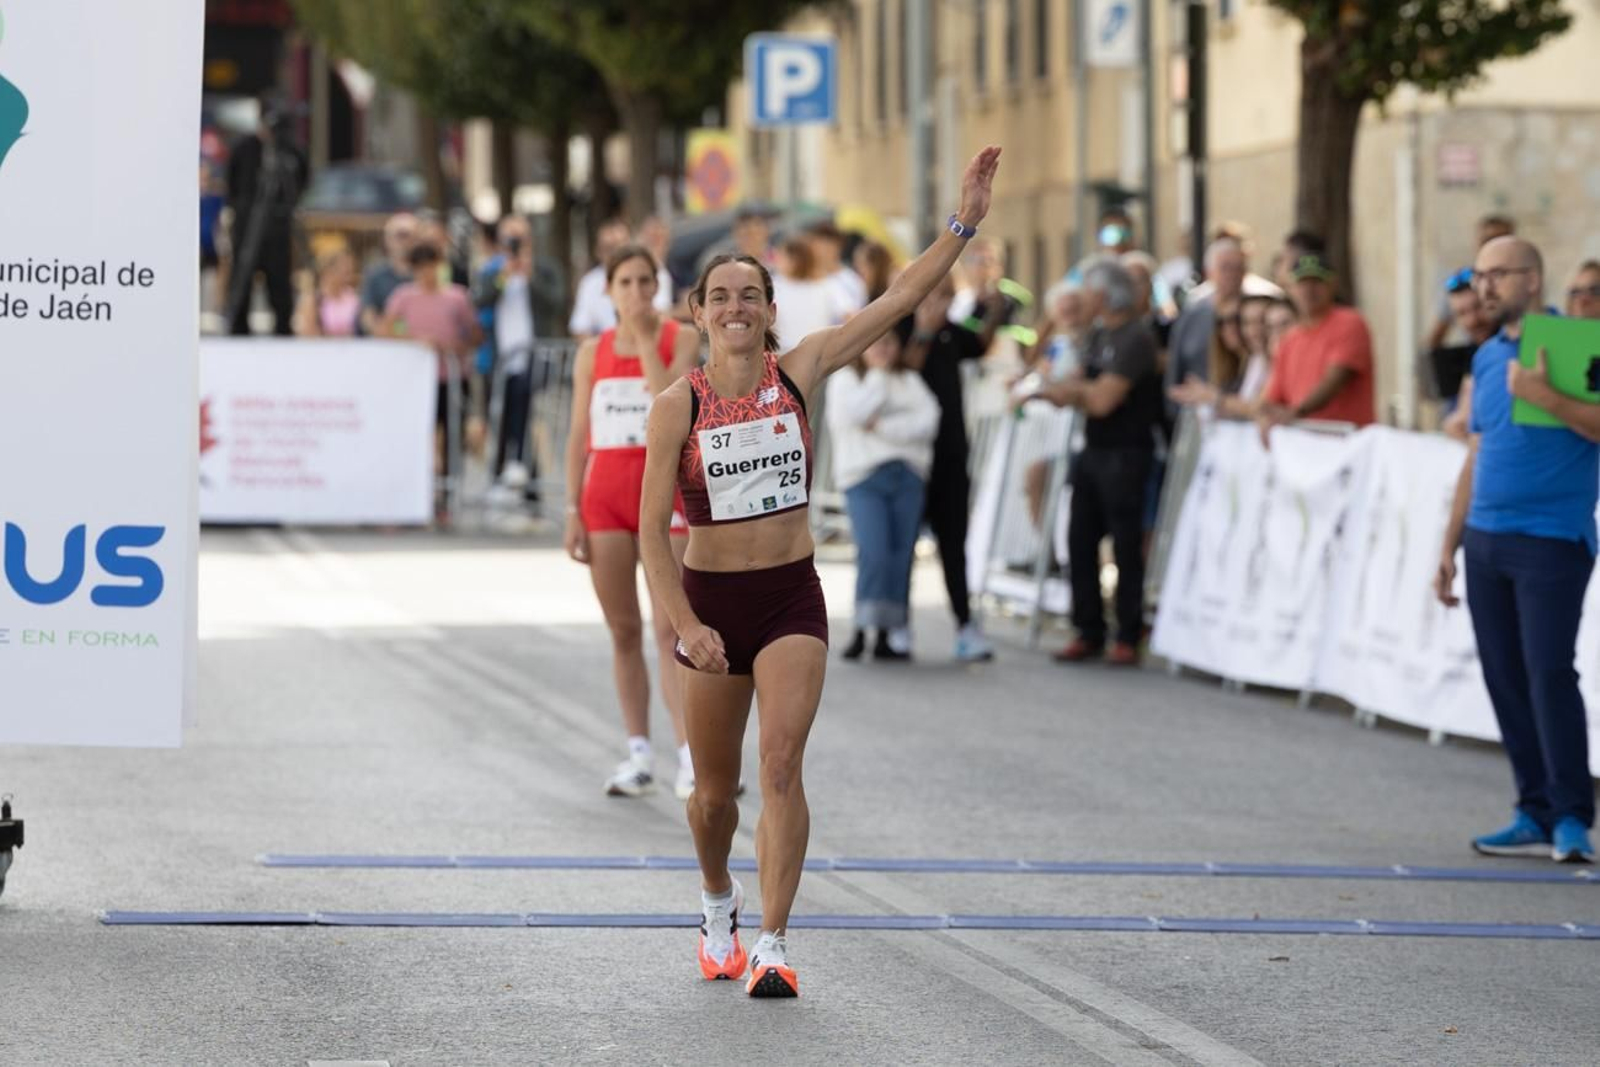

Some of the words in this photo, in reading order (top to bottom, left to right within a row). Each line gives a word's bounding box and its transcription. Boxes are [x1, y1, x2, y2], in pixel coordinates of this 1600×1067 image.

[765, 46, 822, 116] P
[117, 261, 155, 287] de
[39, 293, 112, 321] Jaén
[710, 432, 732, 450] 37
[707, 449, 803, 478] Guerrero
[777, 467, 801, 488] 25
[21, 629, 56, 645] EN
[68, 630, 160, 648] FORMA
